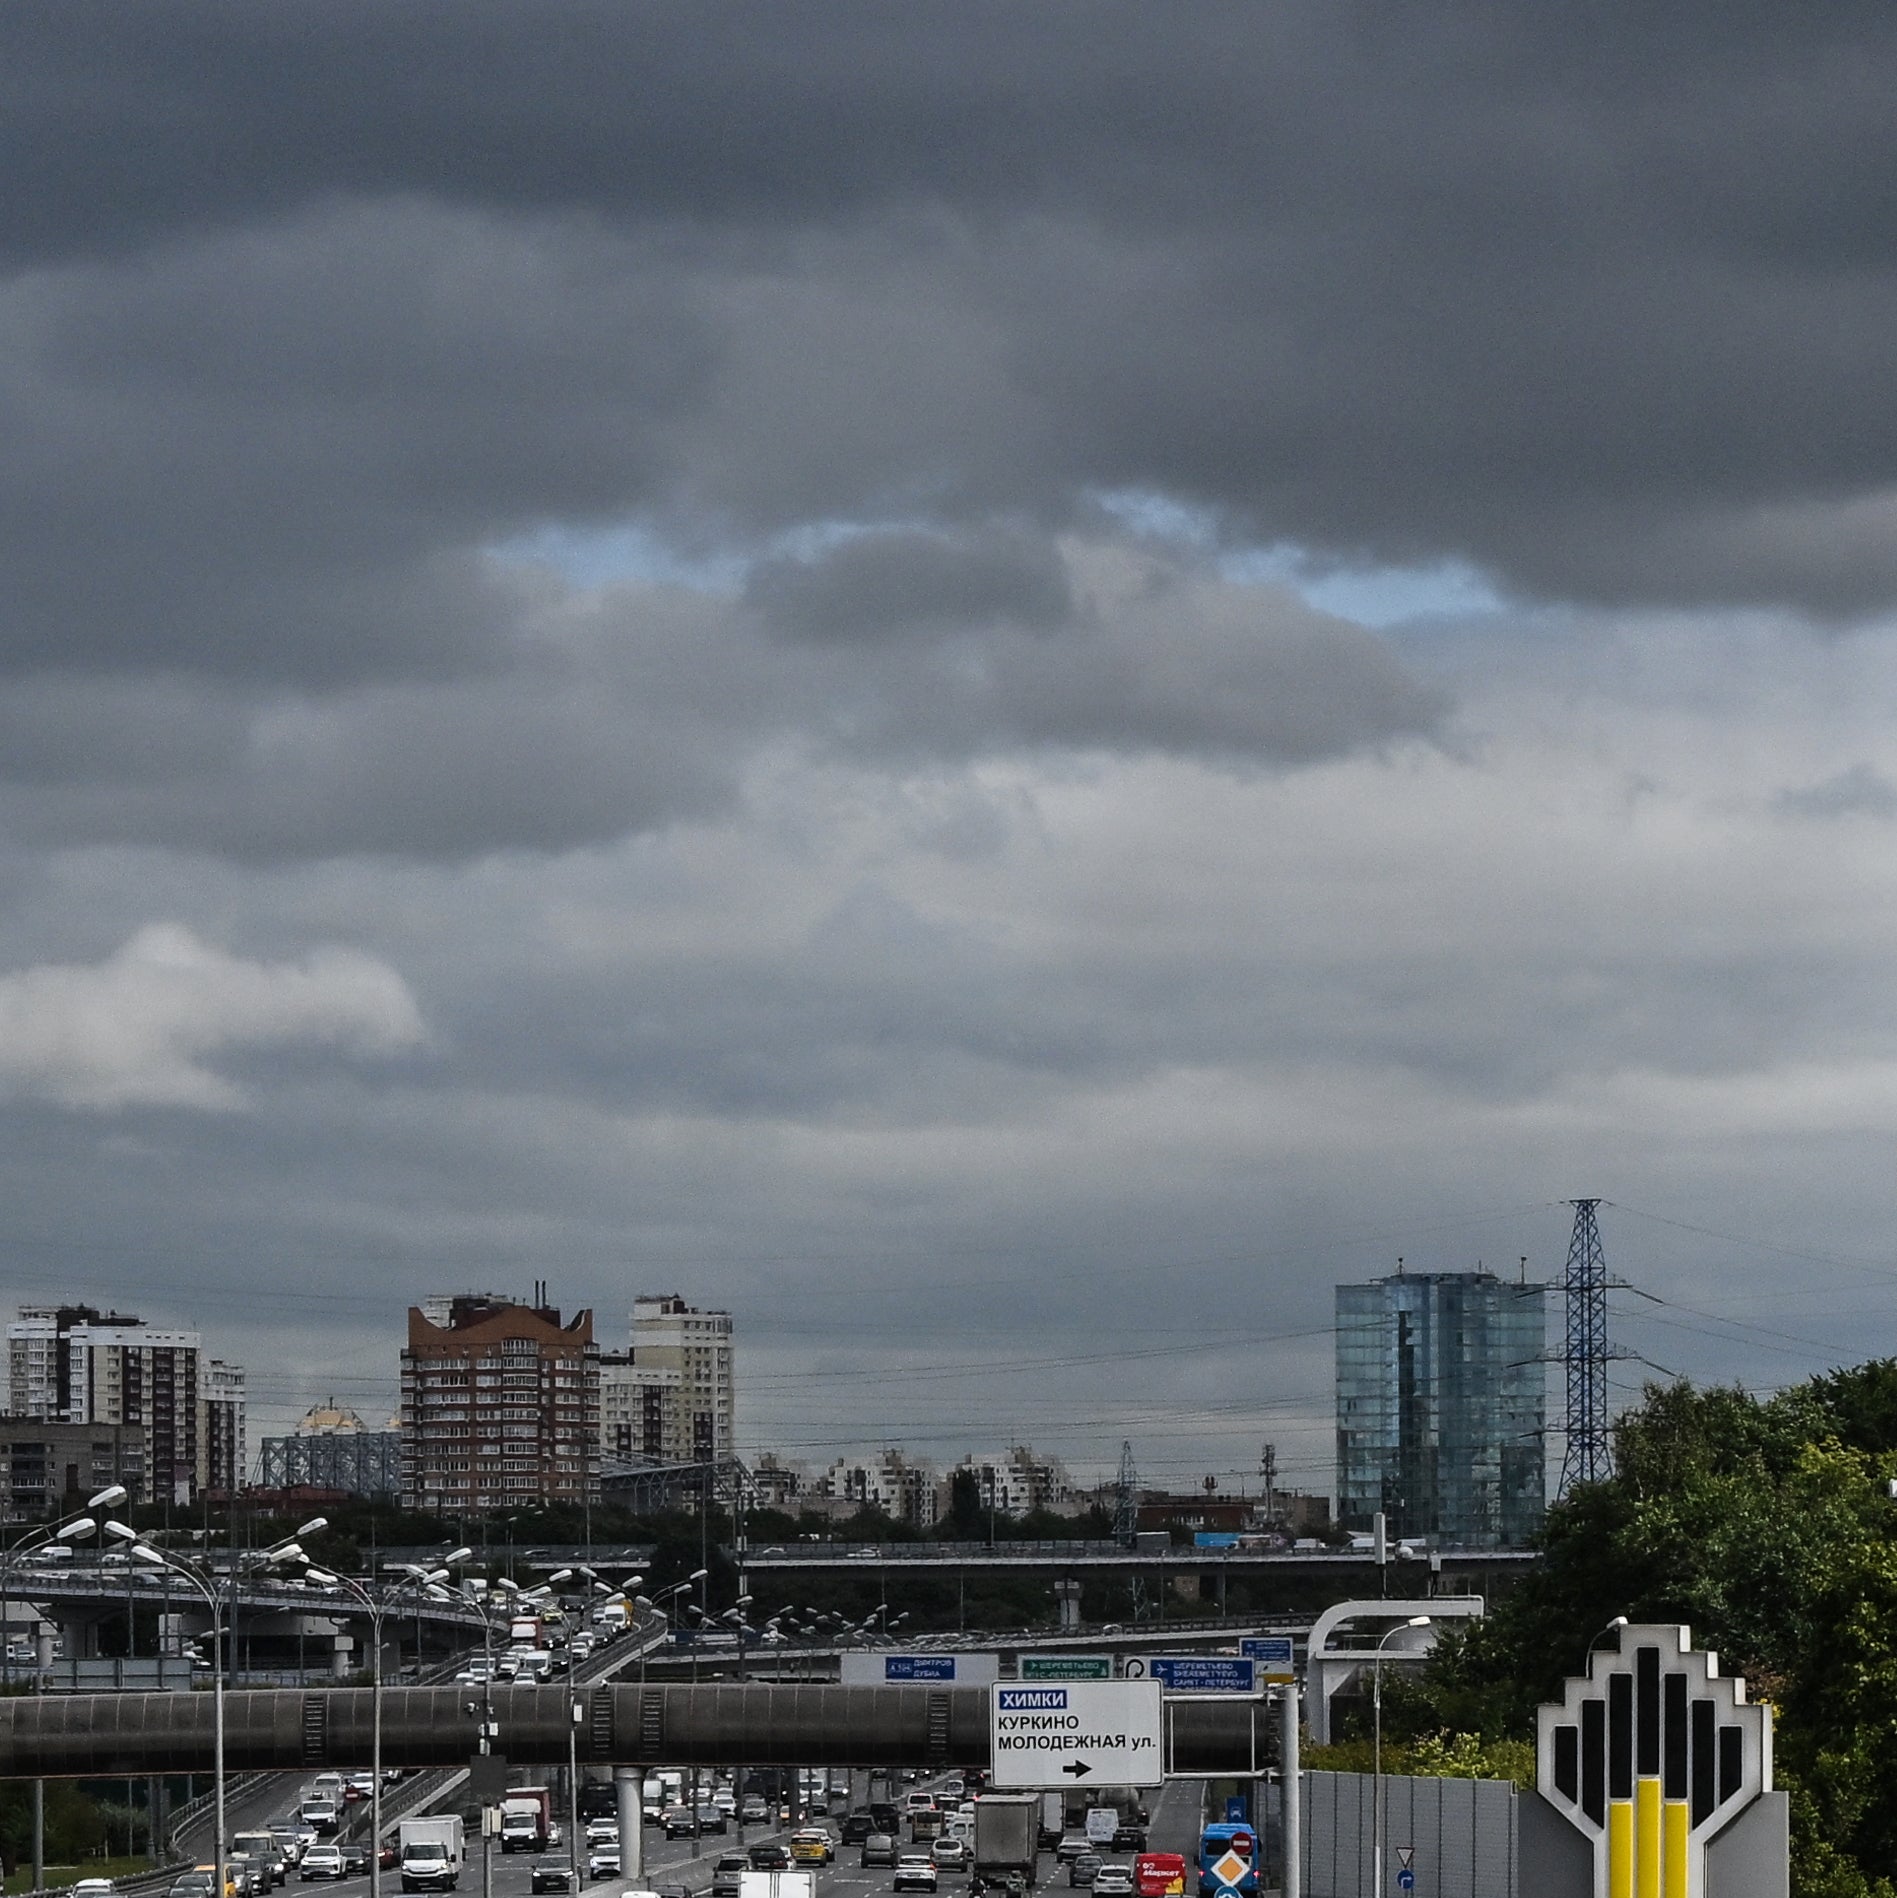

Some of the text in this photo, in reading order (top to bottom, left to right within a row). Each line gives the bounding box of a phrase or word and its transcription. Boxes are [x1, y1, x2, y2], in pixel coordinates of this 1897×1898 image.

[1003, 1693, 1064, 1707] ХИМКИ
[998, 1716, 1079, 1730] КУРКИНО
[998, 1735, 1157, 1751] МОЛОДЕЖНАЯ ул.
